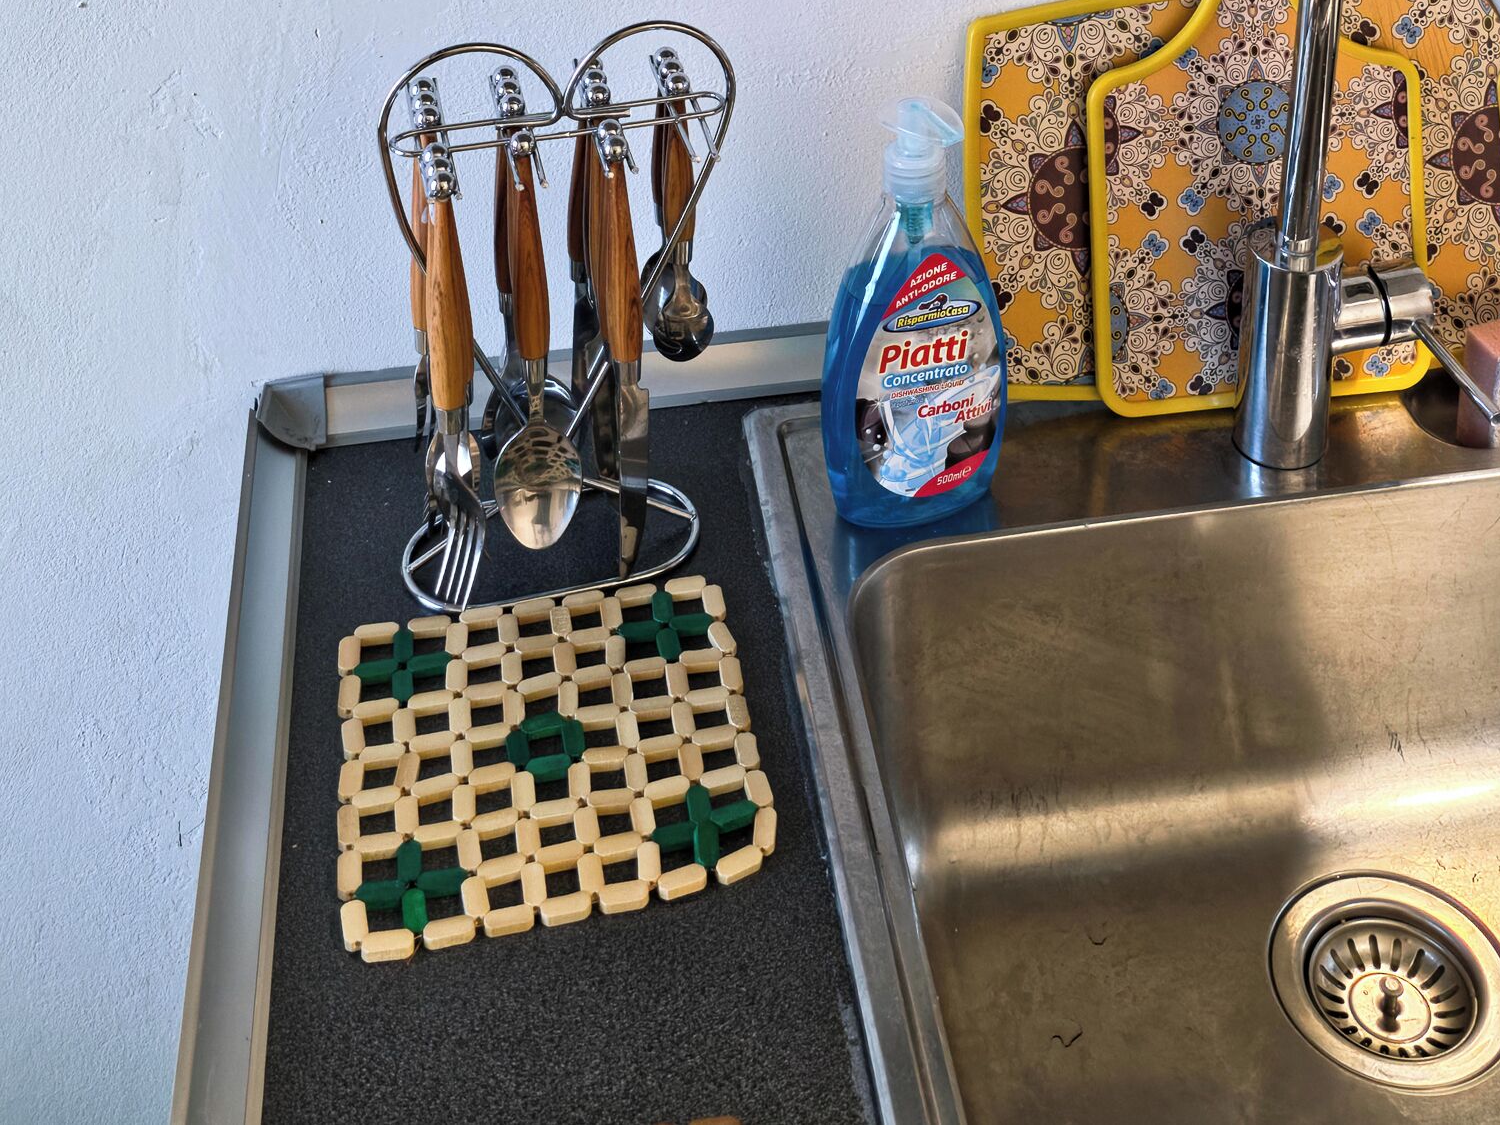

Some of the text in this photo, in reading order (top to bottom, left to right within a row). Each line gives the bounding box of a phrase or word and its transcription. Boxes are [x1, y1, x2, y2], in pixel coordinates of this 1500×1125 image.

[909, 261, 948, 288] AZIONE
[895, 270, 958, 309] ANTI-ODORE
[896, 304, 970, 329] RisparmioCasa
[878, 330, 969, 374] Piatti
[883, 363, 968, 388] Concentrato
[890, 379, 965, 399] DISHWASHING LIQUID
[917, 393, 975, 419] Carboni
[954, 398, 992, 424] Attivi
